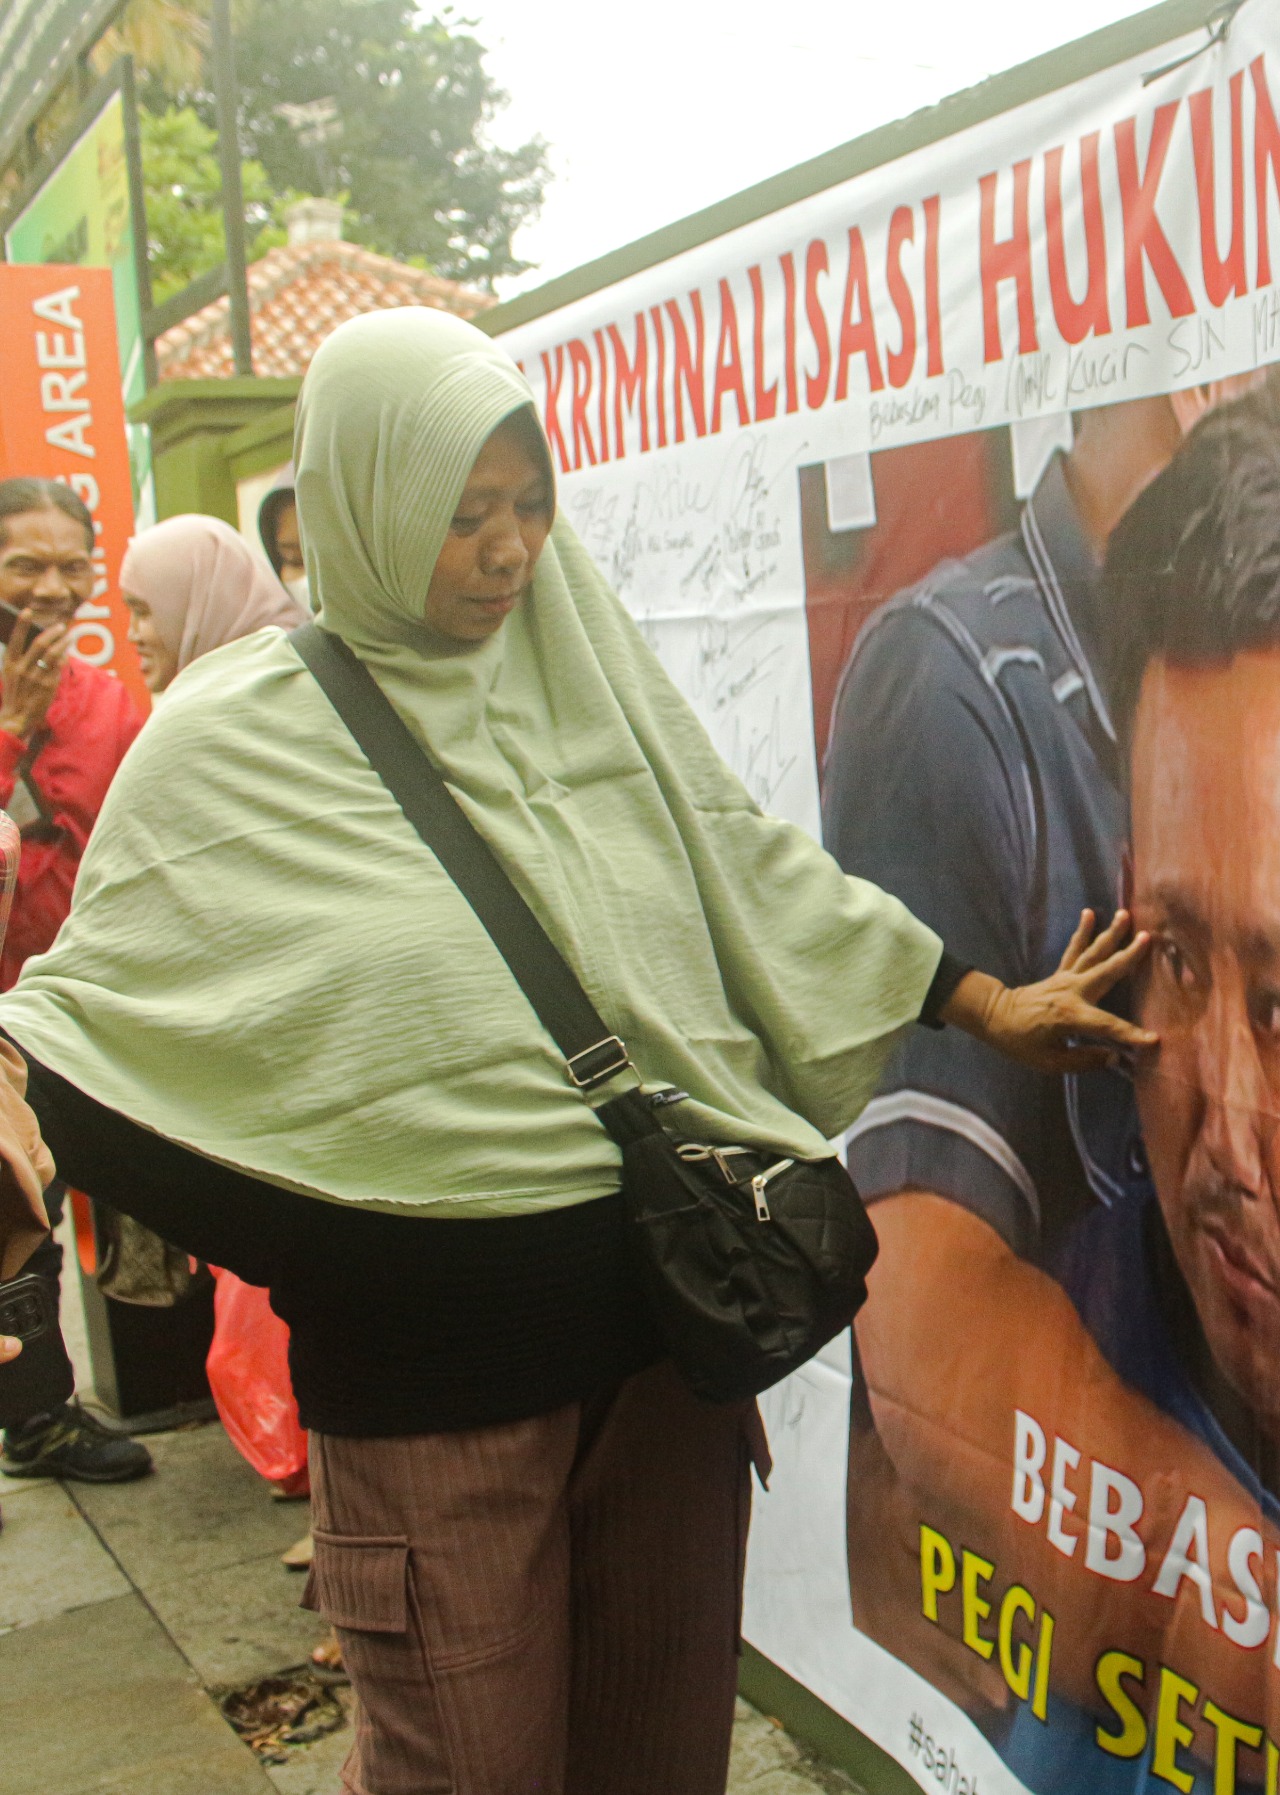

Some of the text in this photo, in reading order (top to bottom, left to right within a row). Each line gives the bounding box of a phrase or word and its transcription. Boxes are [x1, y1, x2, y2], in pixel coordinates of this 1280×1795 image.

[33, 285, 97, 460] AREA
[540, 193, 944, 474] KRIMINALISASI
[918, 1522, 1056, 1722] PEGI
